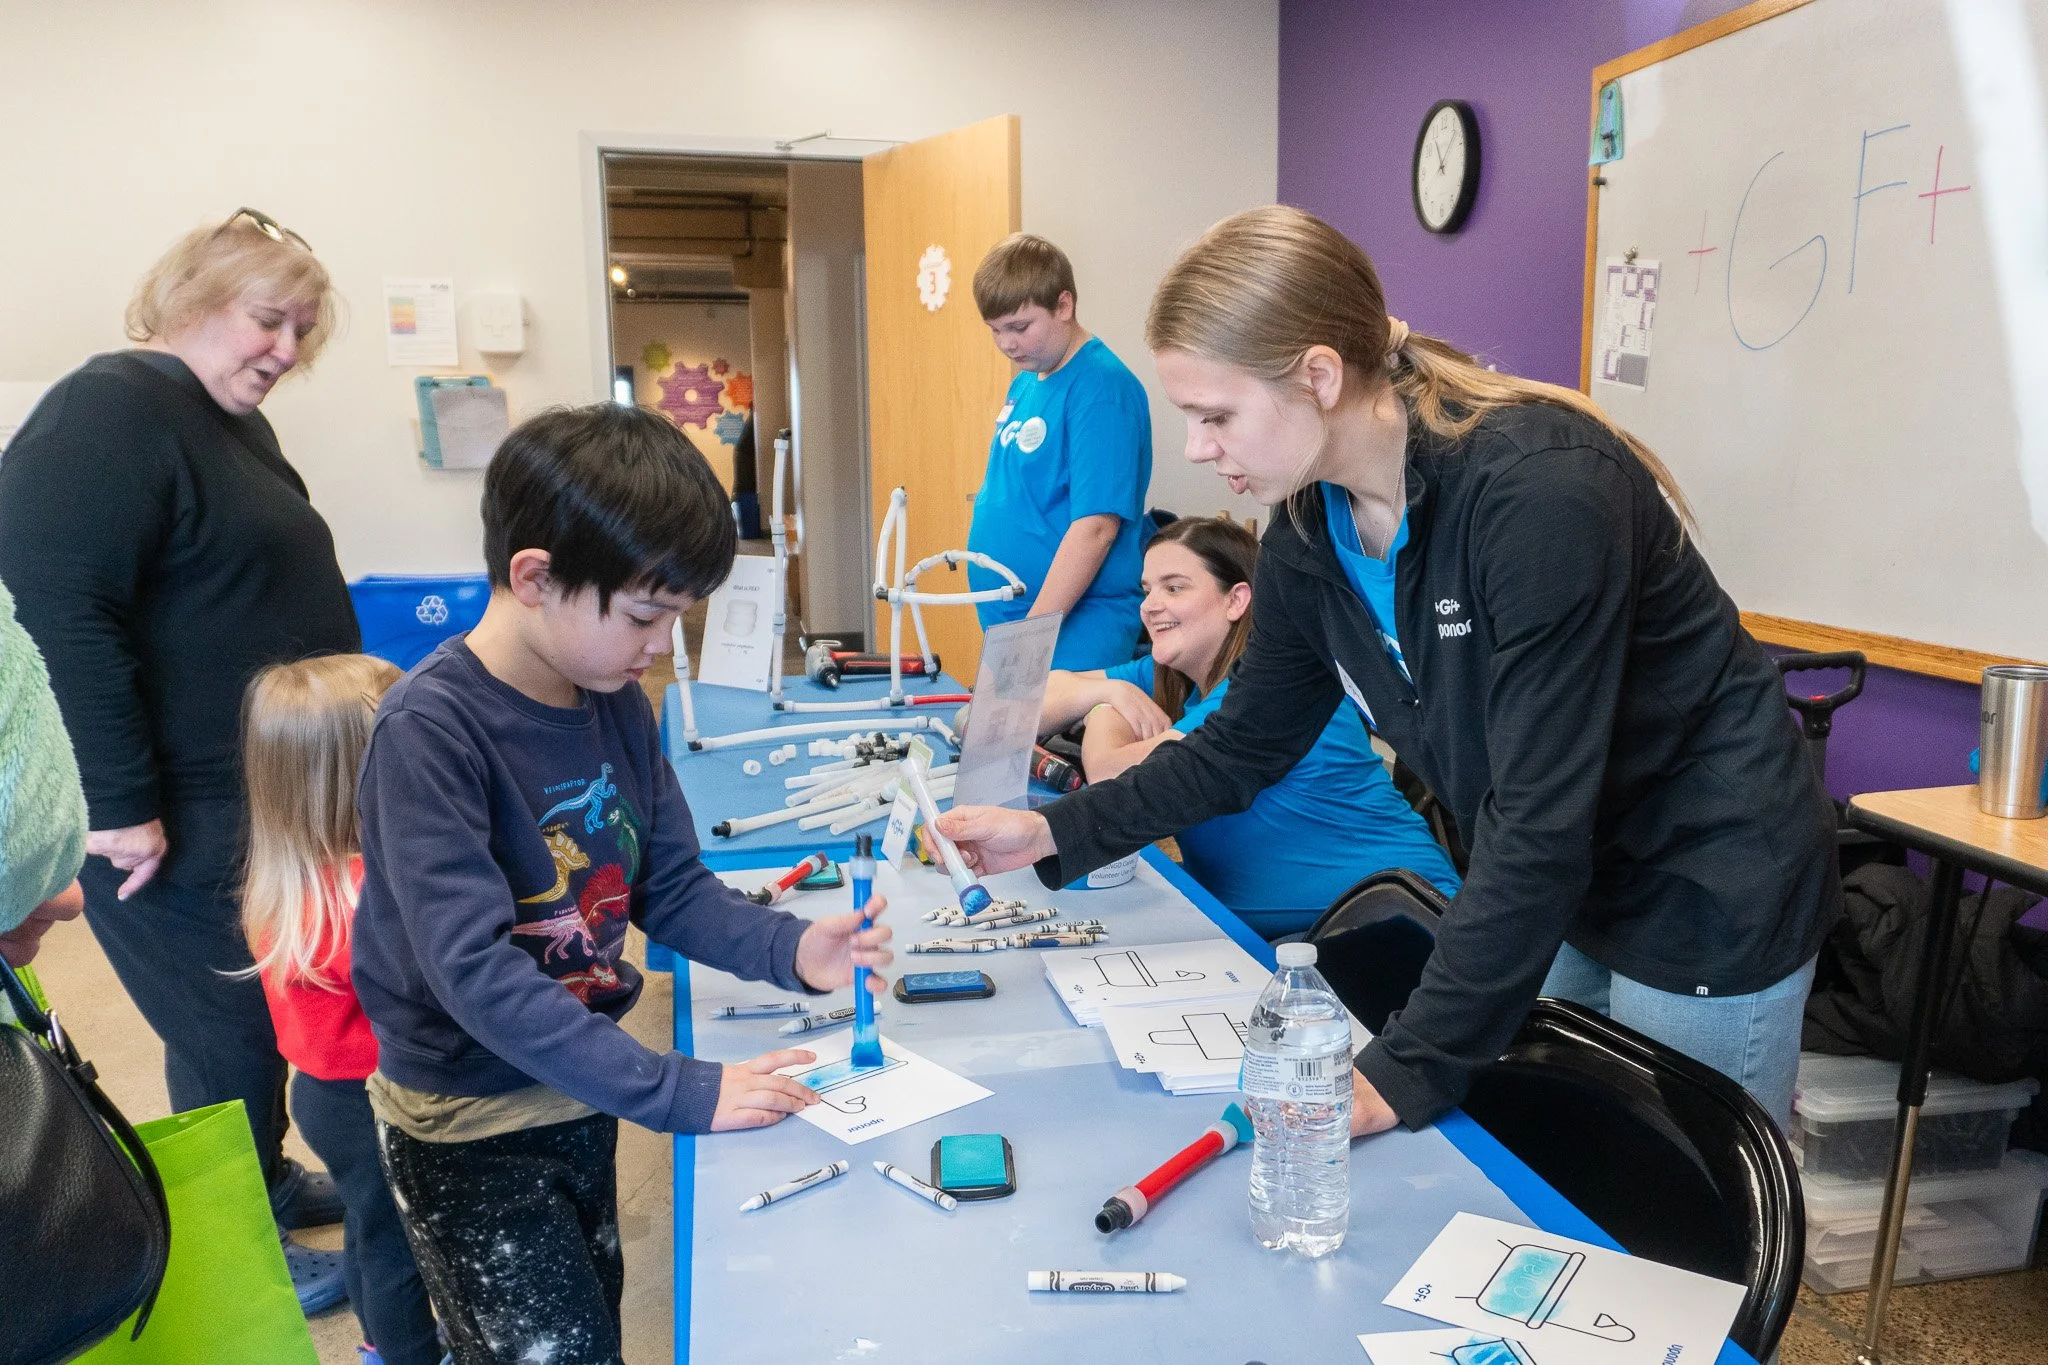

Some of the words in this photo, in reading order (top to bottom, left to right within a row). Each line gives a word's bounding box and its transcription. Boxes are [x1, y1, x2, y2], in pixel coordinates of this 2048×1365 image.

[929, 271, 936, 295] 3
[1437, 618, 1472, 640] ponor
[830, 1007, 856, 1019] Crayola
[847, 1117, 885, 1133] uponor
[1073, 1283, 1113, 1292] Crayola
[1413, 1283, 1432, 1303] +GF+
[1662, 1343, 1684, 1365] upono
